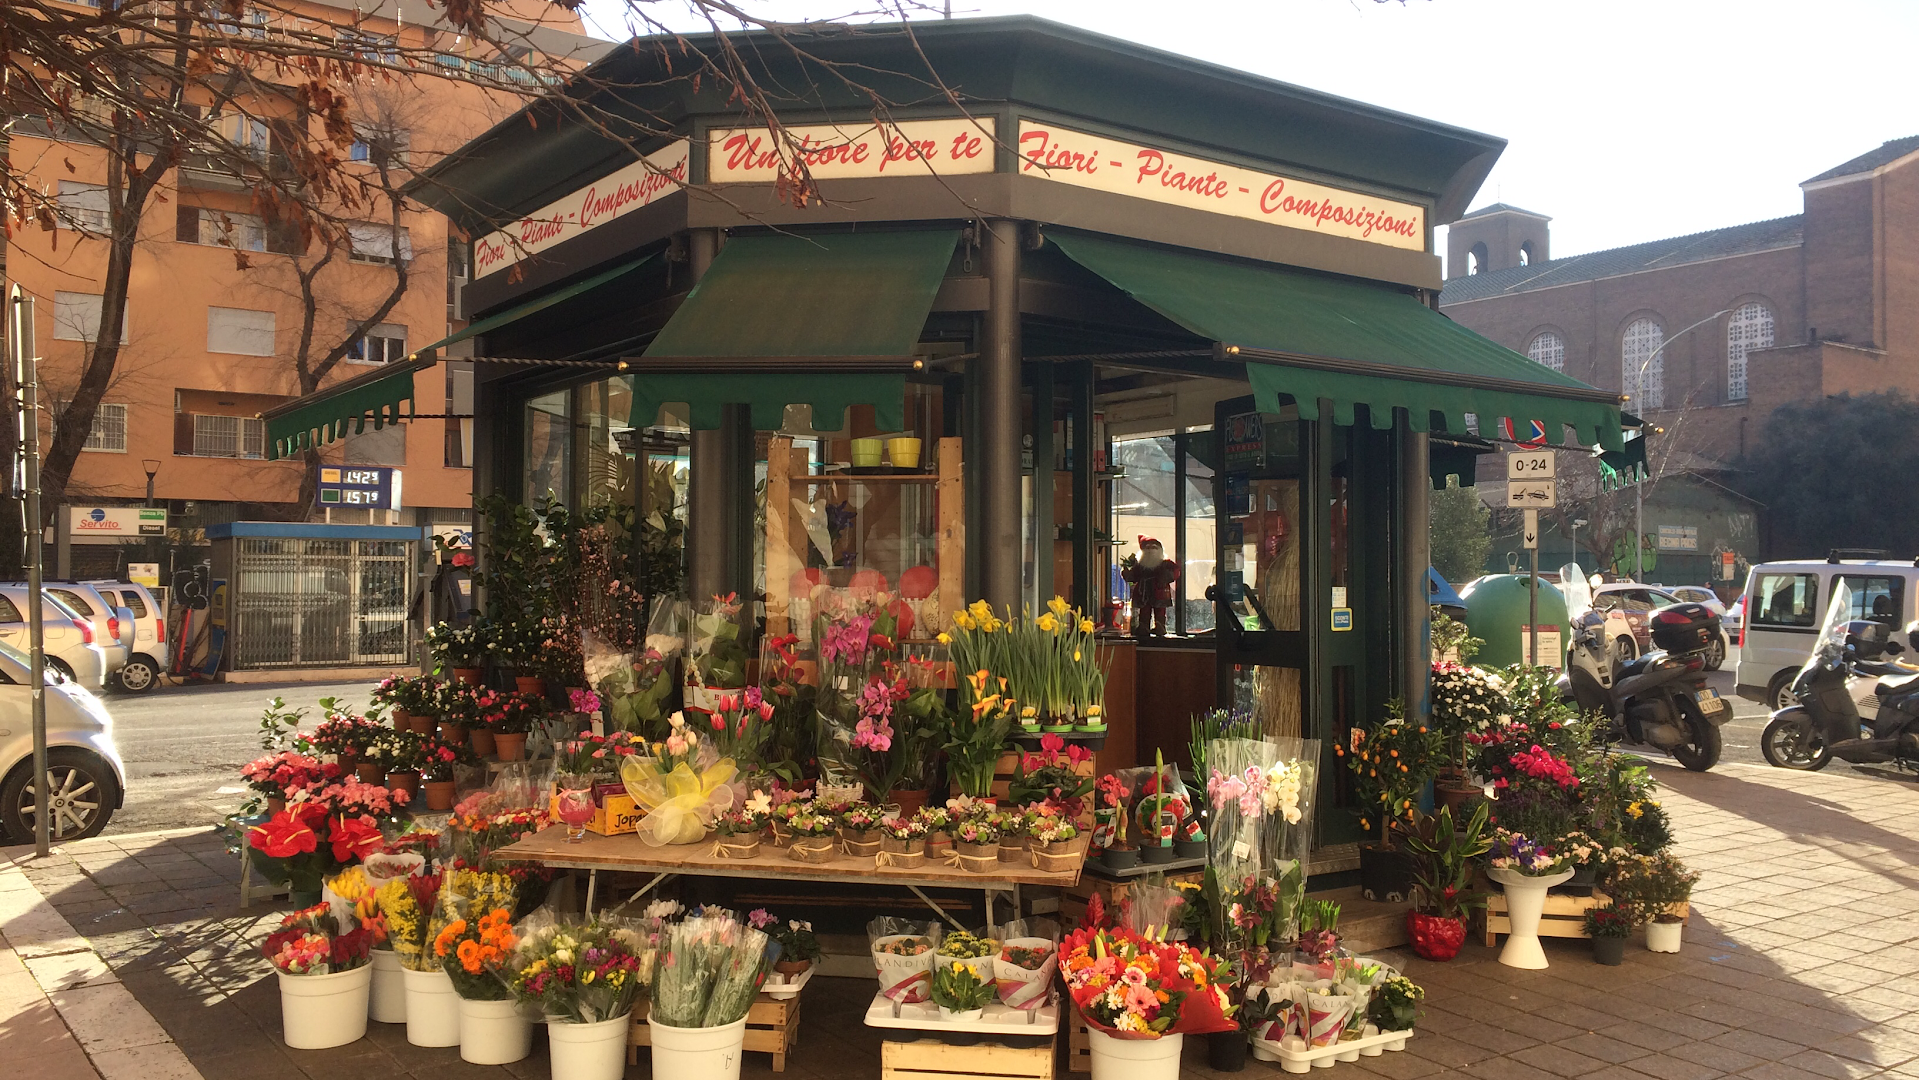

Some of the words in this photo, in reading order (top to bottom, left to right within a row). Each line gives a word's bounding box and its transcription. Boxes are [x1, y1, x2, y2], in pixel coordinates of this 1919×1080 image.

[723, 134, 781, 171] Un
[791, 133, 870, 180] fiore
[879, 135, 939, 173] per
[950, 131, 984, 161] te
[1019, 130, 1099, 175] Fiori
[1136, 149, 1229, 199] Piante
[1259, 179, 1417, 238] Composizioni
[476, 239, 506, 276] Fiori
[520, 215, 564, 247] Piante
[579, 153, 688, 229] Composizioni
[80, 519, 119, 529] Servito
